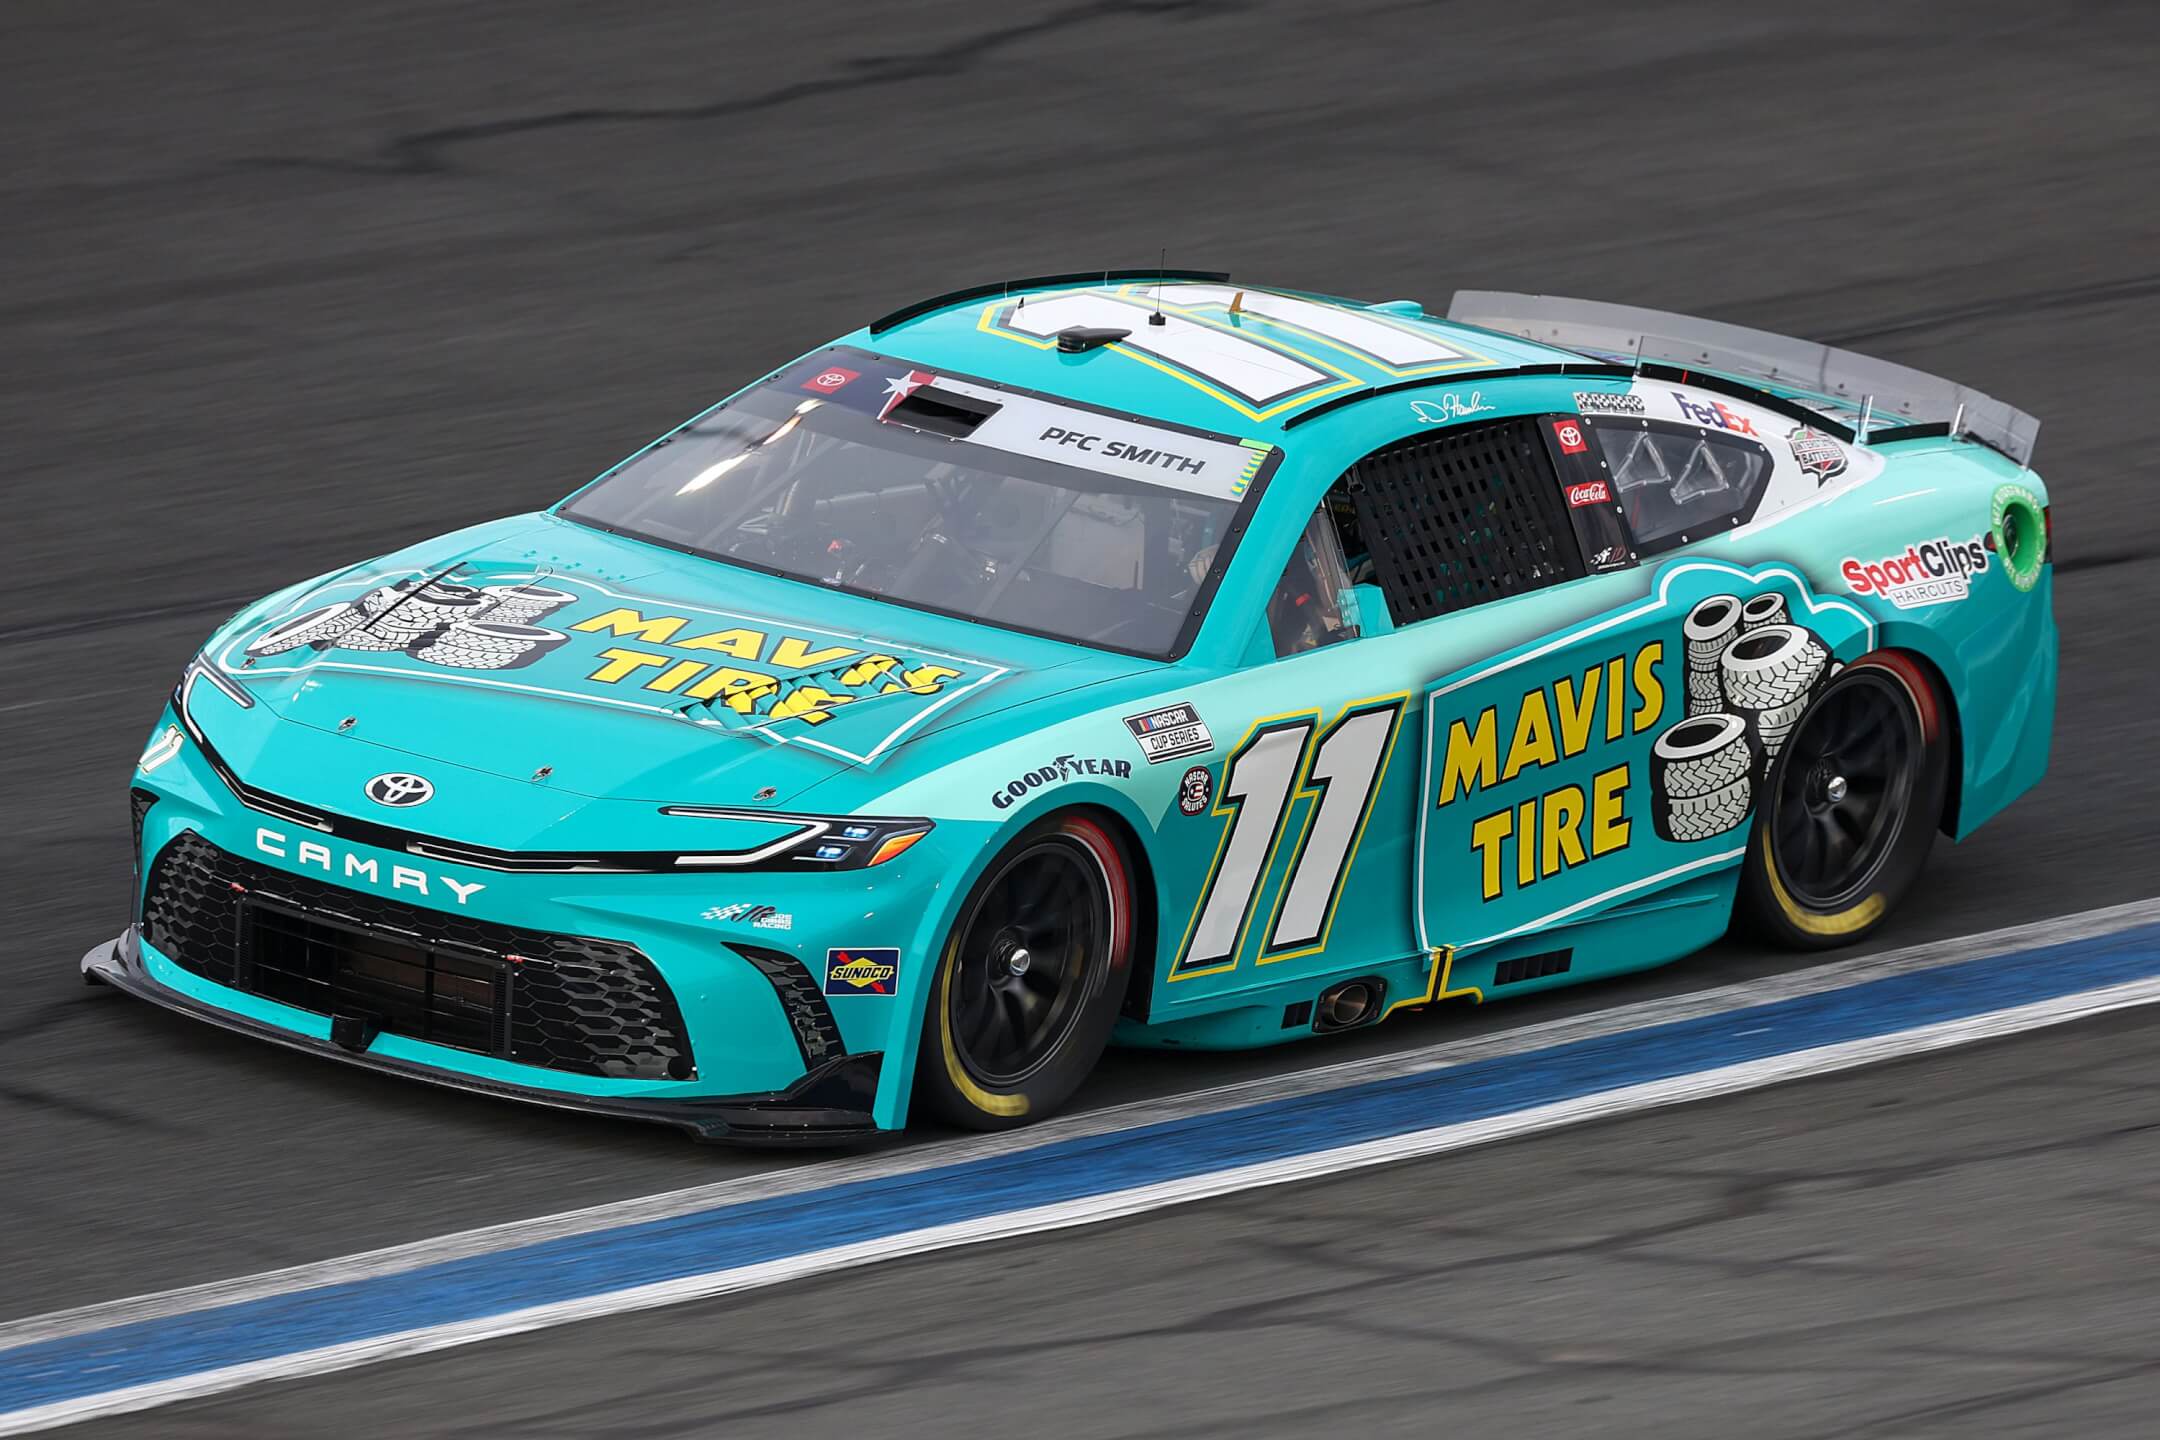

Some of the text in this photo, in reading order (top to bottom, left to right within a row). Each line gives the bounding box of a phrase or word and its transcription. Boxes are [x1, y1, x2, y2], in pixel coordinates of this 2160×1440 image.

[1670, 391, 1759, 438] FedEx
[1038, 426, 1206, 475] PFC SMITH
[1893, 579, 1964, 603] HAIRCUTS
[585, 647, 856, 727] TIRE
[1150, 727, 1200, 750] CUP SERIES
[1151, 709, 1189, 729] NASCAR
[1437, 640, 1665, 809] MAVIS
[992, 757, 1132, 809] GOODYEAR
[1184, 770, 1209, 787] NASCAR
[1170, 693, 1408, 978] 11
[1470, 761, 1634, 904] TIRE
[256, 827, 487, 905] CAMRY
[752, 922, 792, 930] RACING
[833, 966, 892, 980] SUNOCO
